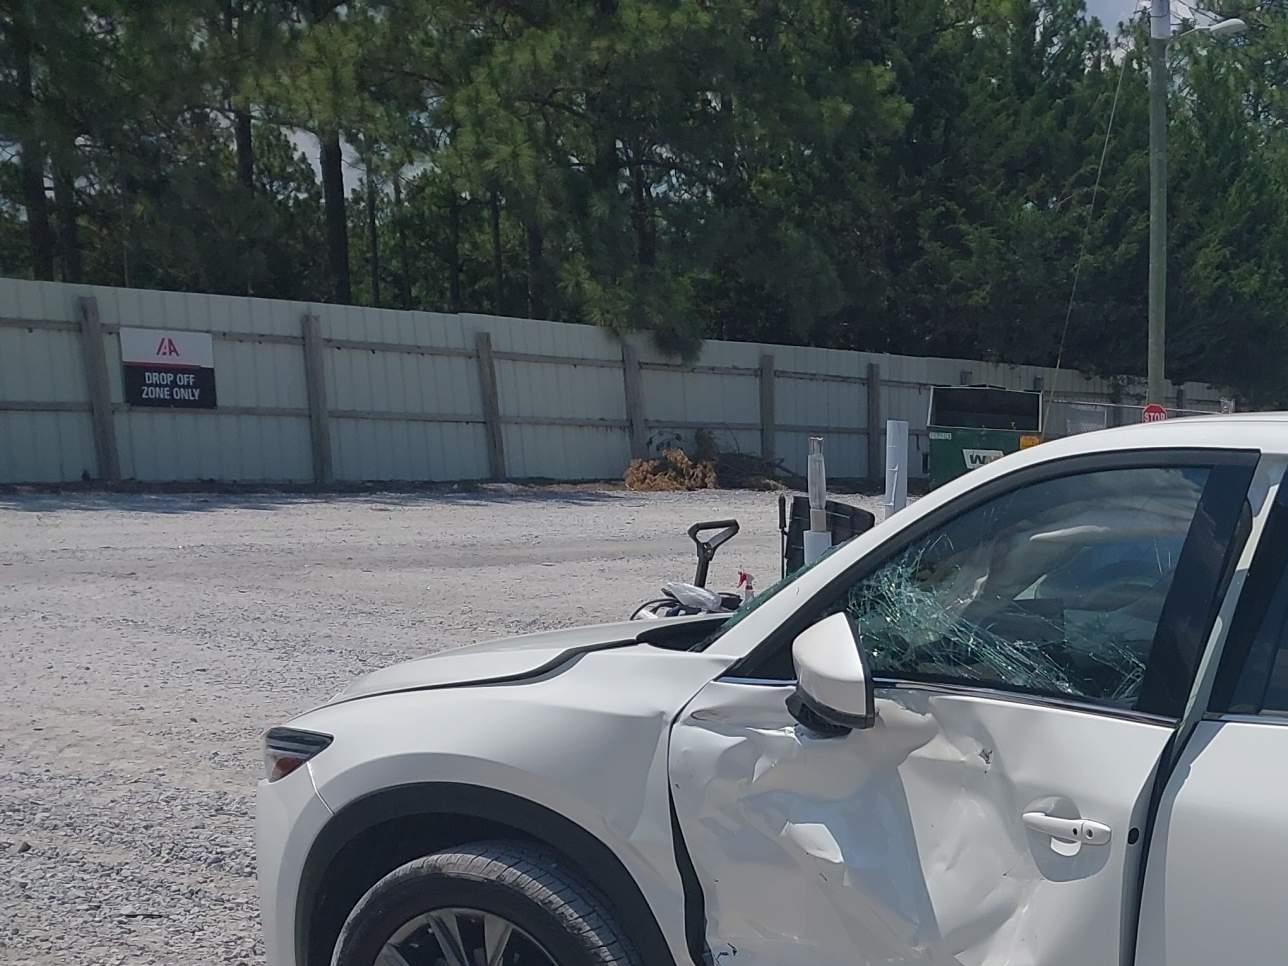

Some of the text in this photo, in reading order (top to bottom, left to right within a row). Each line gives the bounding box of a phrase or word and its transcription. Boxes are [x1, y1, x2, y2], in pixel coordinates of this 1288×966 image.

[145, 372, 195, 386] DROP OFF
[142, 386, 200, 400] ZONE ONLY
[1143, 412, 1166, 423] STOP
